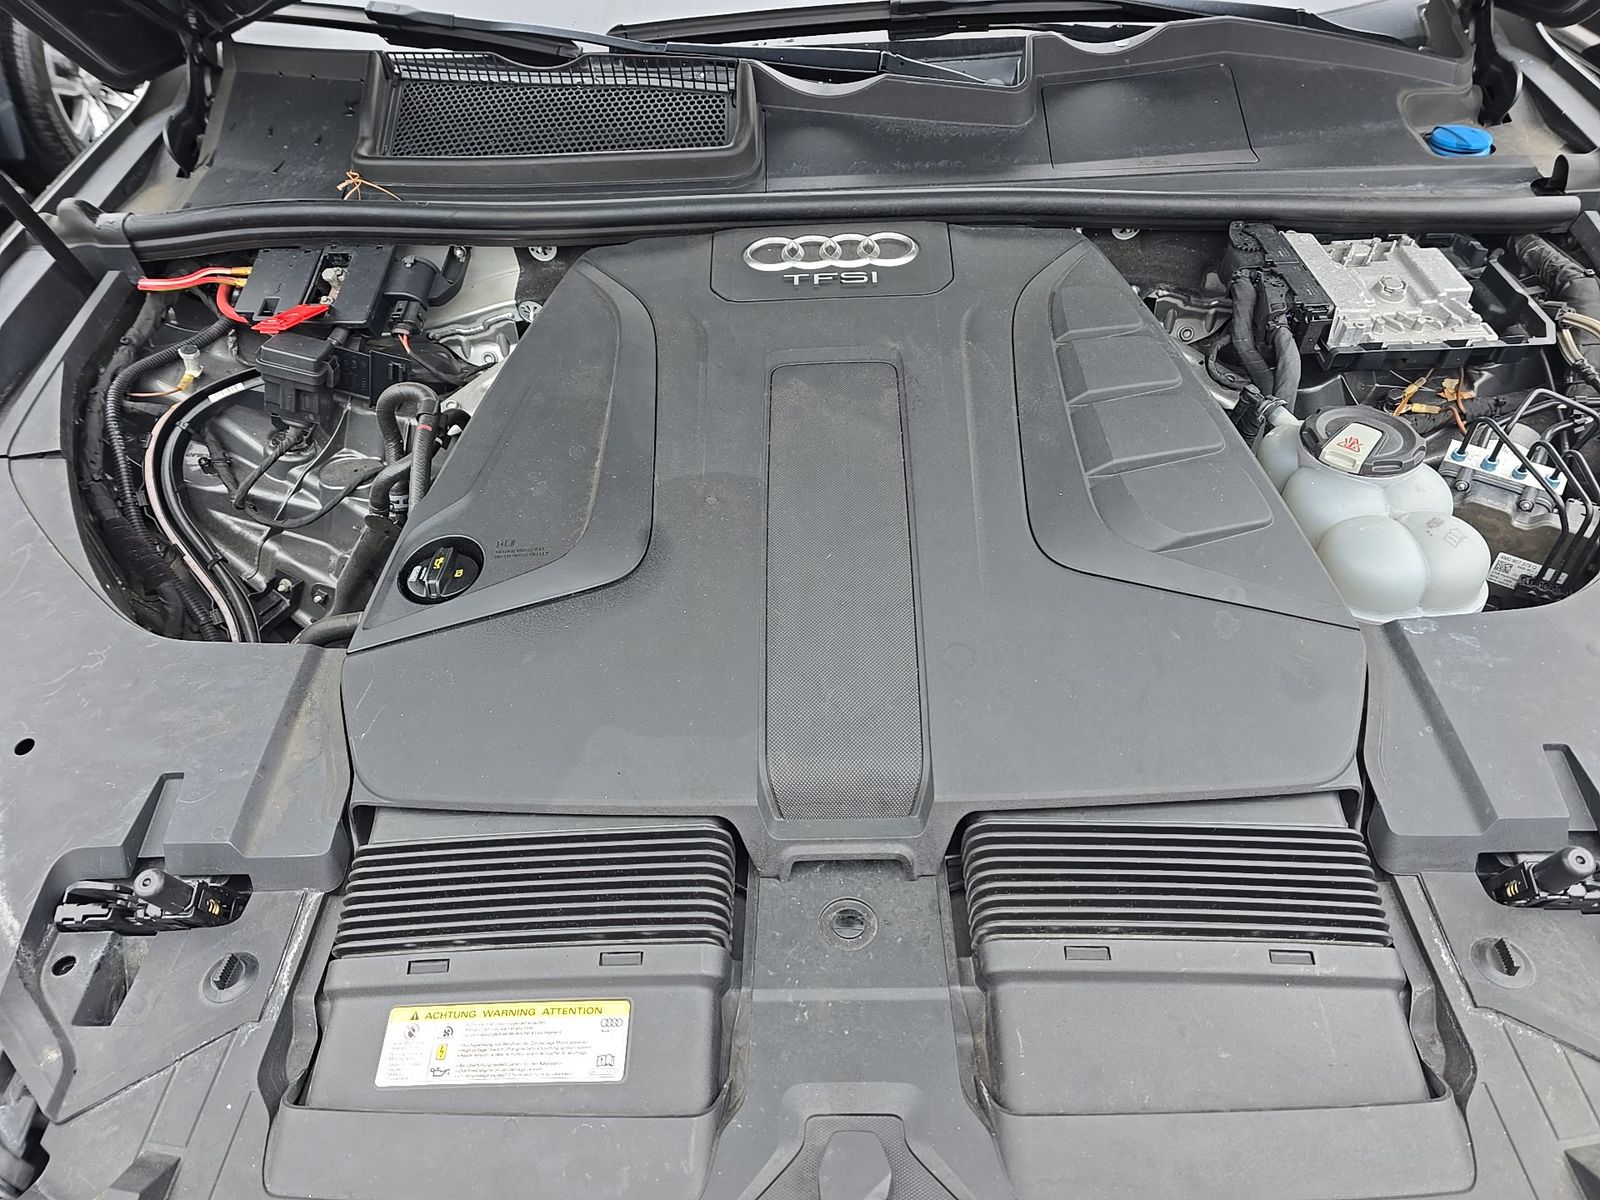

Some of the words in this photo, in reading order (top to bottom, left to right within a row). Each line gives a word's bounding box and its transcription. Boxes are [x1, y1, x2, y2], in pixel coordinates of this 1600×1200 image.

[783, 271, 878, 286] TFSI
[425, 1010, 477, 1020] ACHTUNG
[483, 1008, 536, 1018] WARNING
[542, 1006, 603, 1016] ATTENTION
